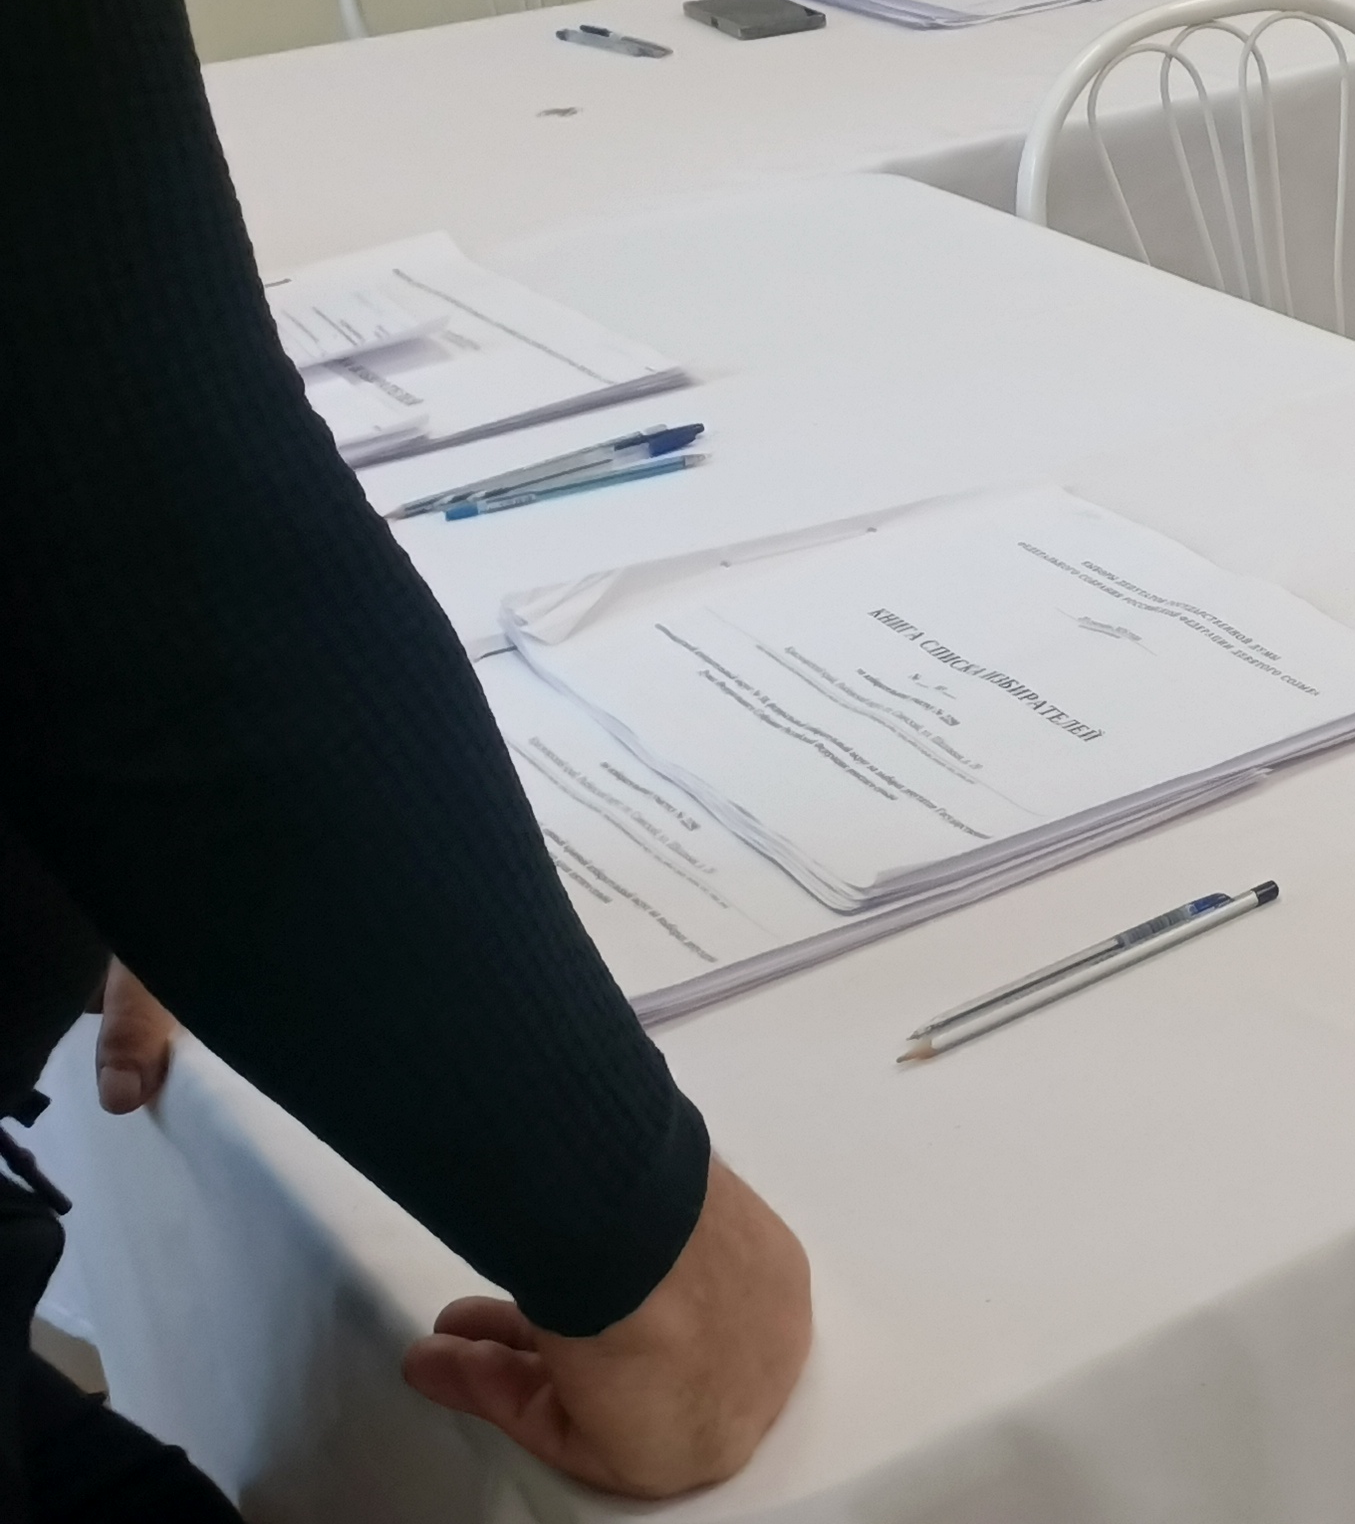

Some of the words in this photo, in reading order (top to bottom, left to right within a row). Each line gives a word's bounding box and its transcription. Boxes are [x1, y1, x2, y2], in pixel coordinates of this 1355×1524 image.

[867, 607, 925, 642] КНИГА
[919, 638, 987, 677] СПИСКА
[979, 669, 1106, 743] ИЗБИРАТЕЛЕЙ
